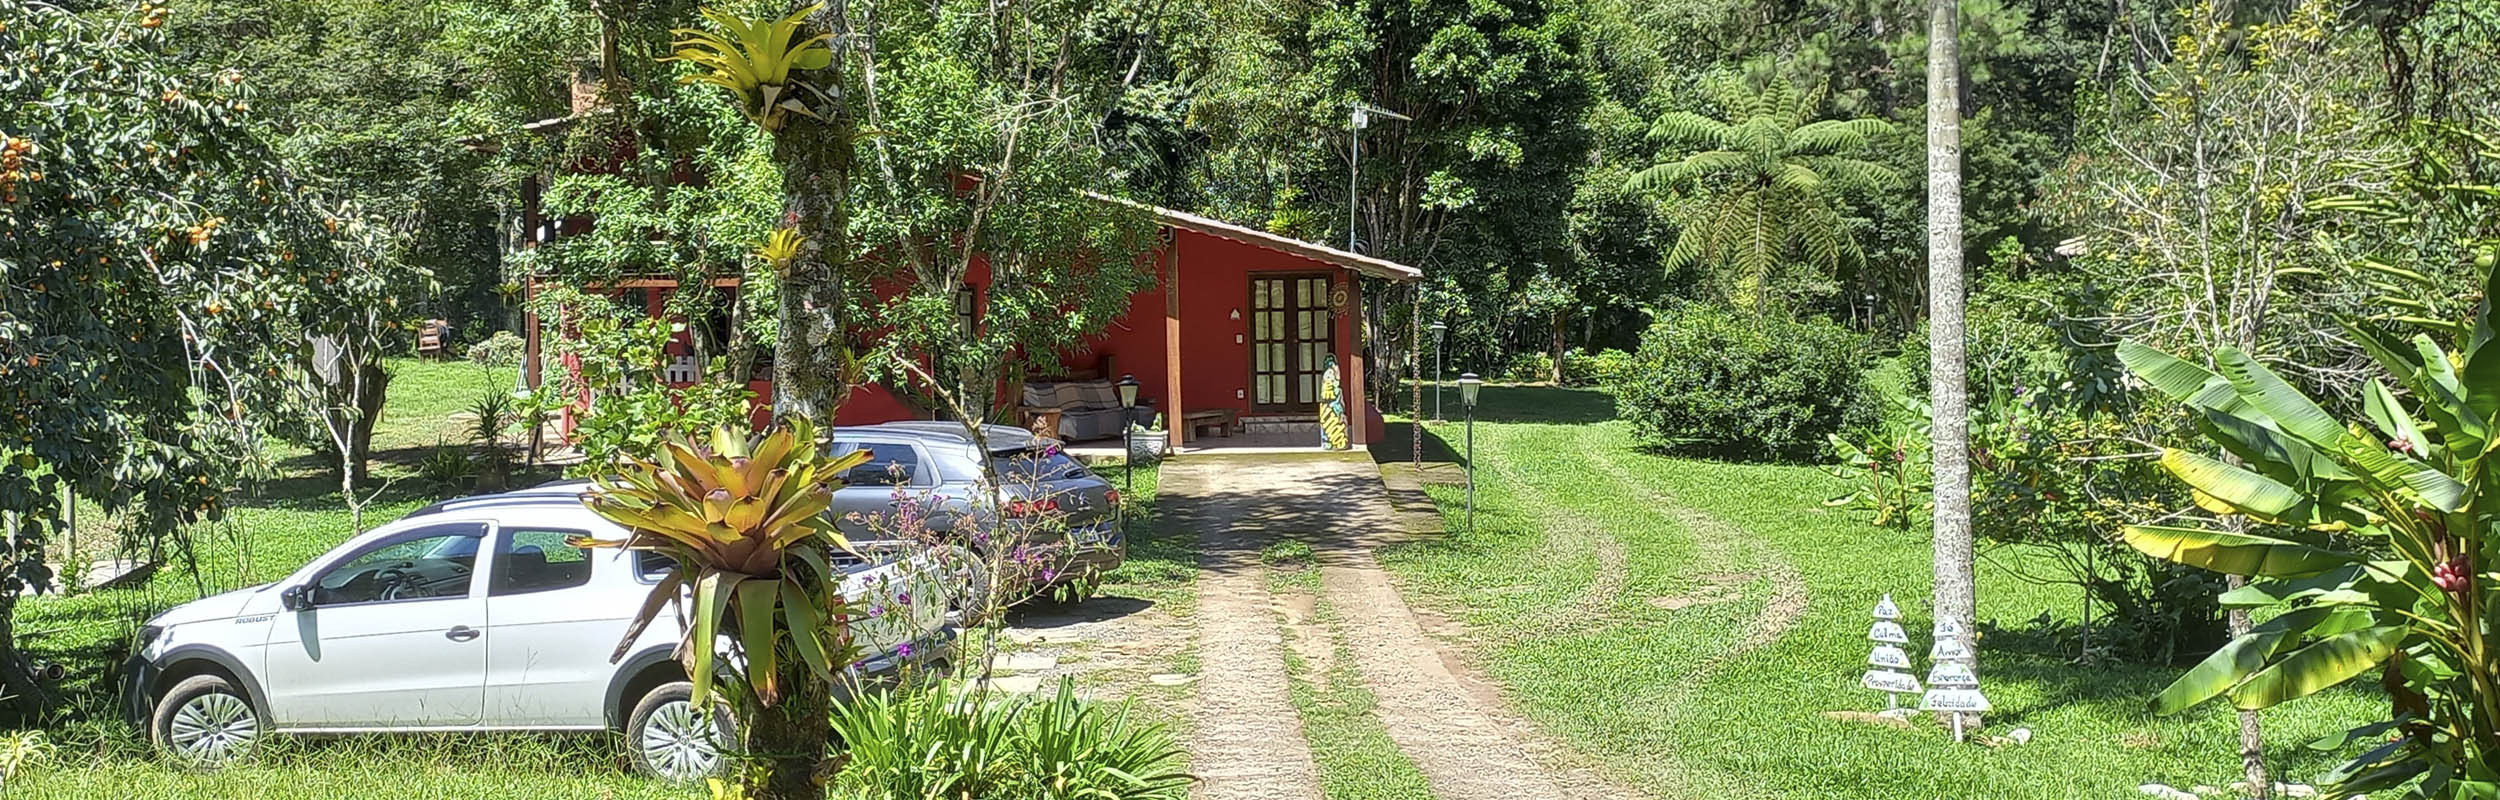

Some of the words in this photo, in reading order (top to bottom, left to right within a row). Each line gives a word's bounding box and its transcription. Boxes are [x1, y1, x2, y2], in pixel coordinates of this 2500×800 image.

[1878, 604, 1893, 615] Paz
[235, 615, 275, 624] ROBUST
[1874, 627, 1903, 639] Calma
[1936, 645, 1964, 657] Amor
[1874, 651, 1899, 664] União
[1865, 674, 1915, 691] Prosperidade
[1932, 671, 1972, 685] Esperança
[1930, 694, 1977, 708] Felicidade
